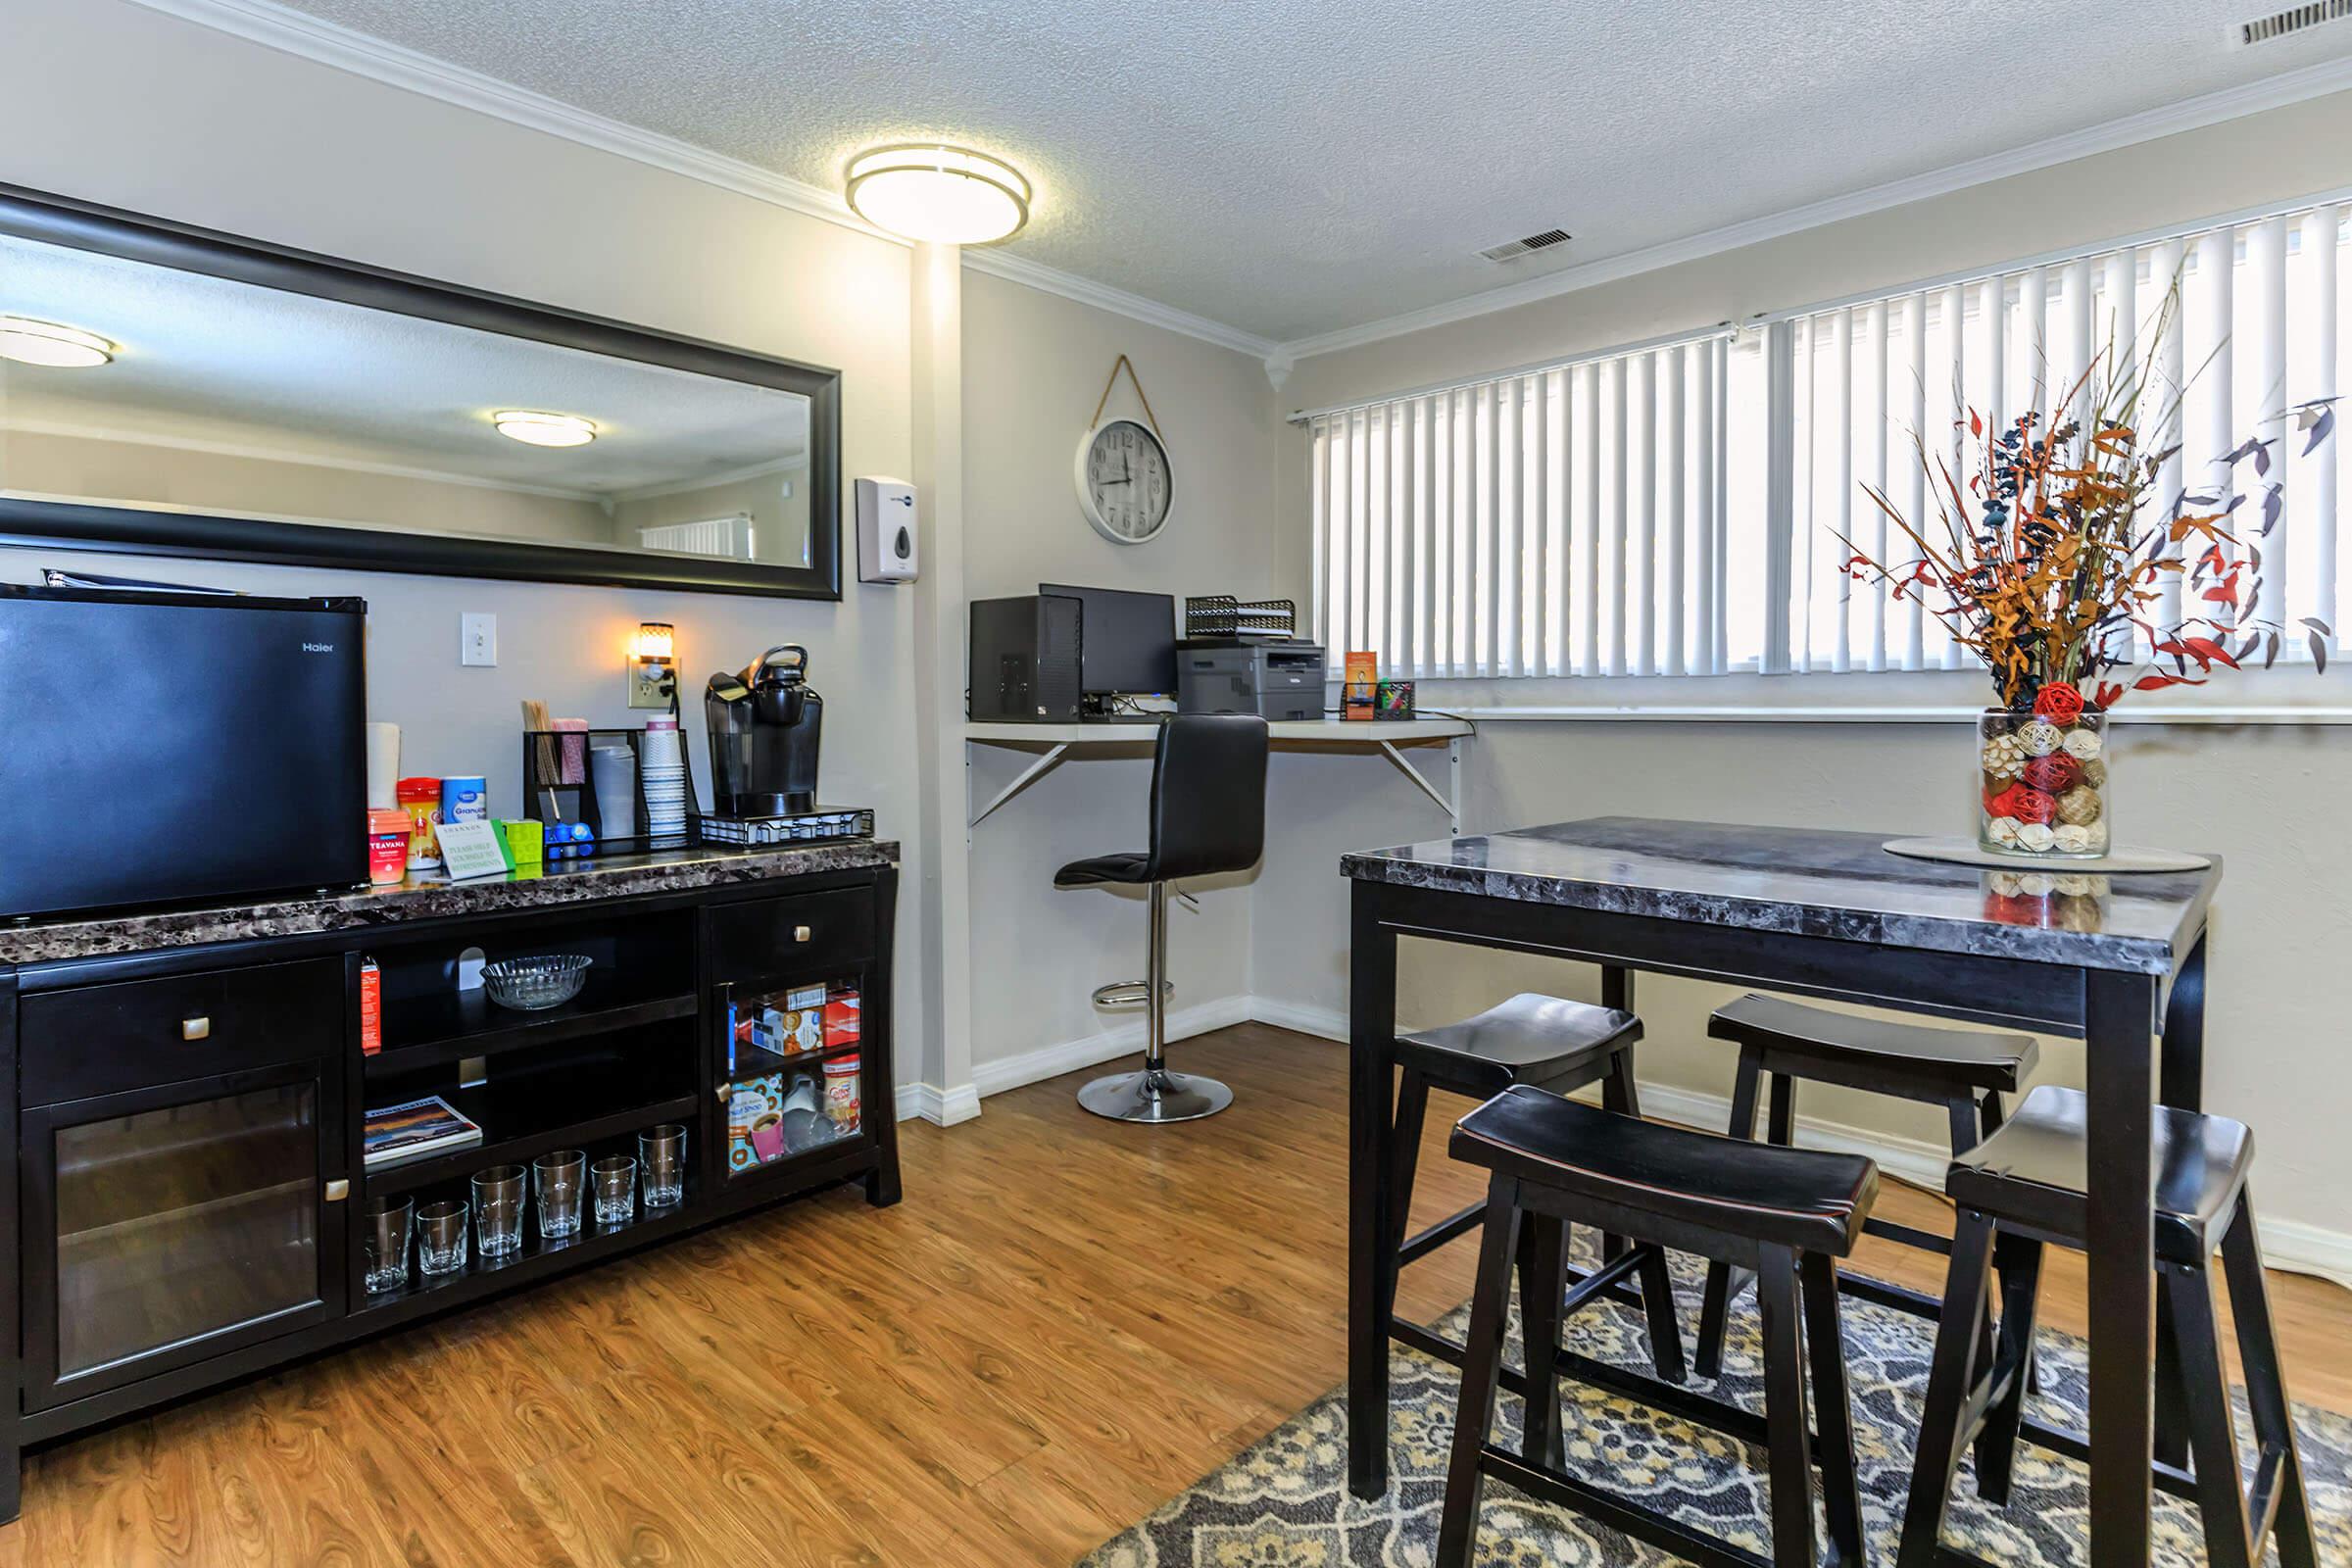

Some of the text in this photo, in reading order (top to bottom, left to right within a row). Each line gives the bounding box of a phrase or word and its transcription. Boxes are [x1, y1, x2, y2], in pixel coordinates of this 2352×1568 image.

[1106, 431, 1117, 450] 11
[1120, 431, 1133, 449] 12
[1095, 448, 1106, 464] 10
[1148, 458, 1156, 474] 2
[1092, 467, 1100, 483] 9
[1152, 478, 1161, 495] 3
[1097, 491, 1105, 506] 8
[1108, 506, 1117, 524] 7
[1122, 508, 1131, 529] 6
[1138, 510, 1147, 526] 5
[303, 642, 333, 652] Haier
